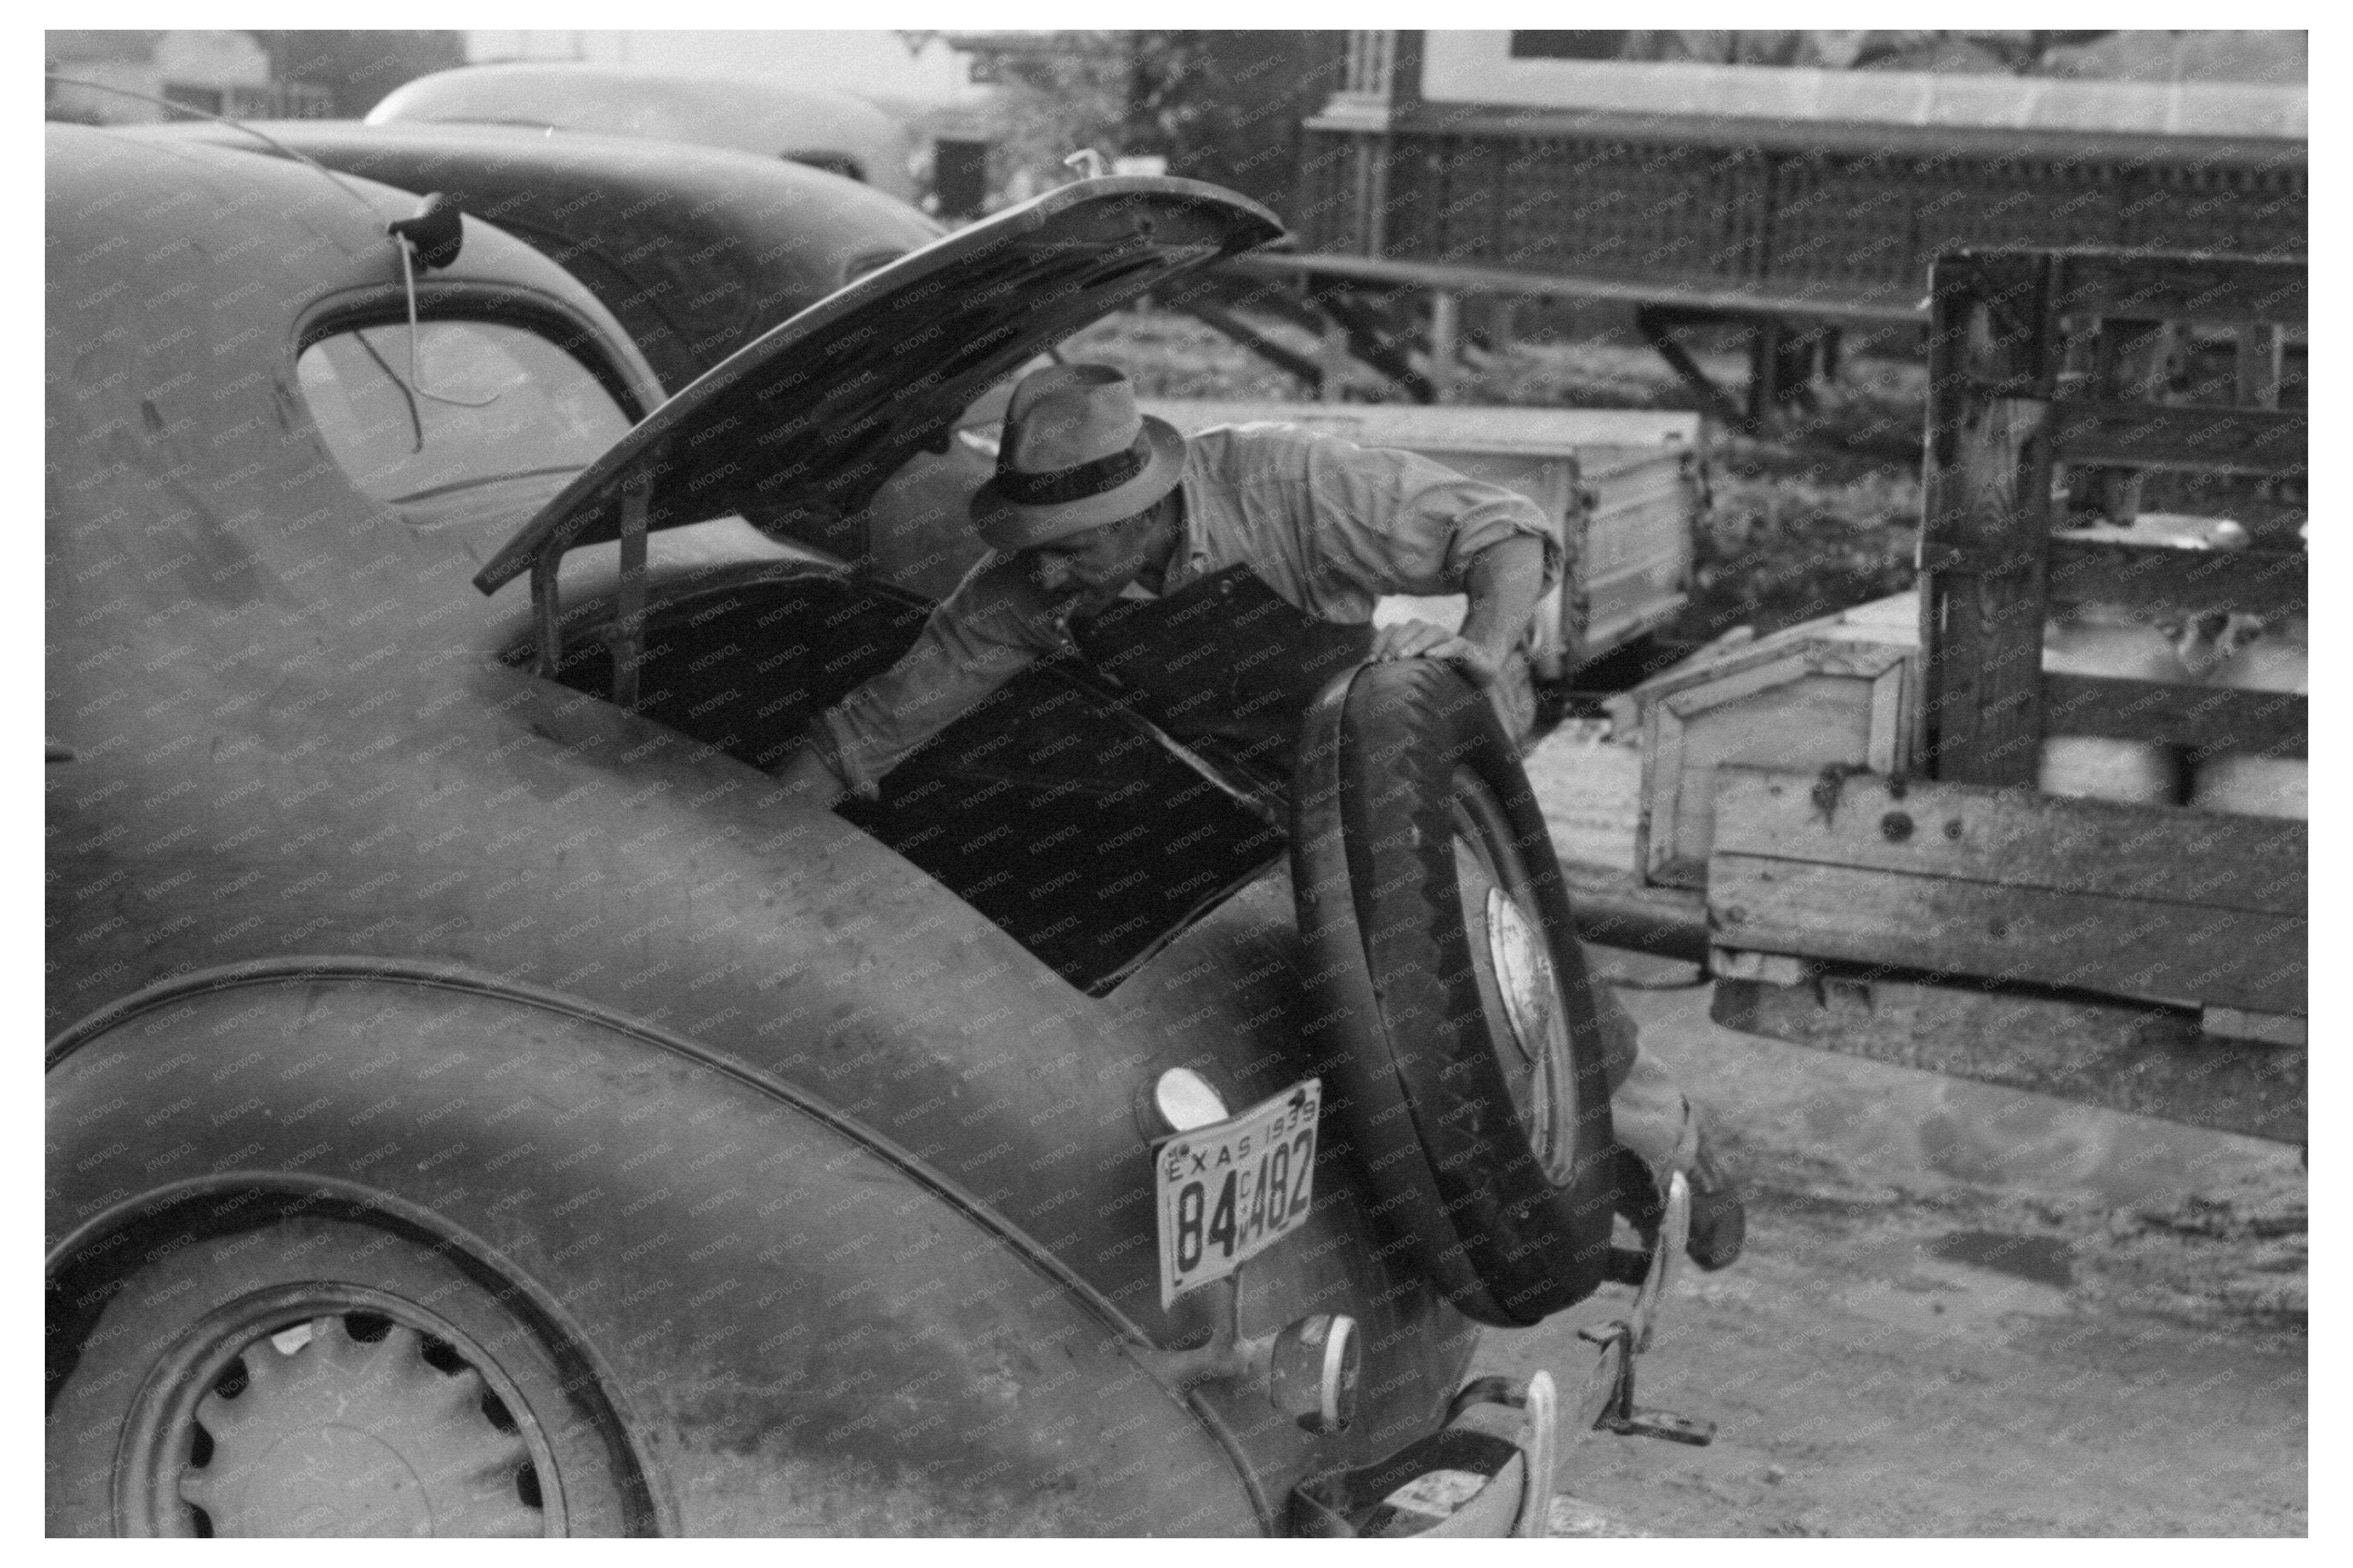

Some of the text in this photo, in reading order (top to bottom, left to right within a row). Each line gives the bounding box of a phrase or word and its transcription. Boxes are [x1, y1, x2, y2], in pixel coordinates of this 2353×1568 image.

[1265, 1100, 1316, 1145] 1939
[1177, 1128, 1313, 1273] 84 482
